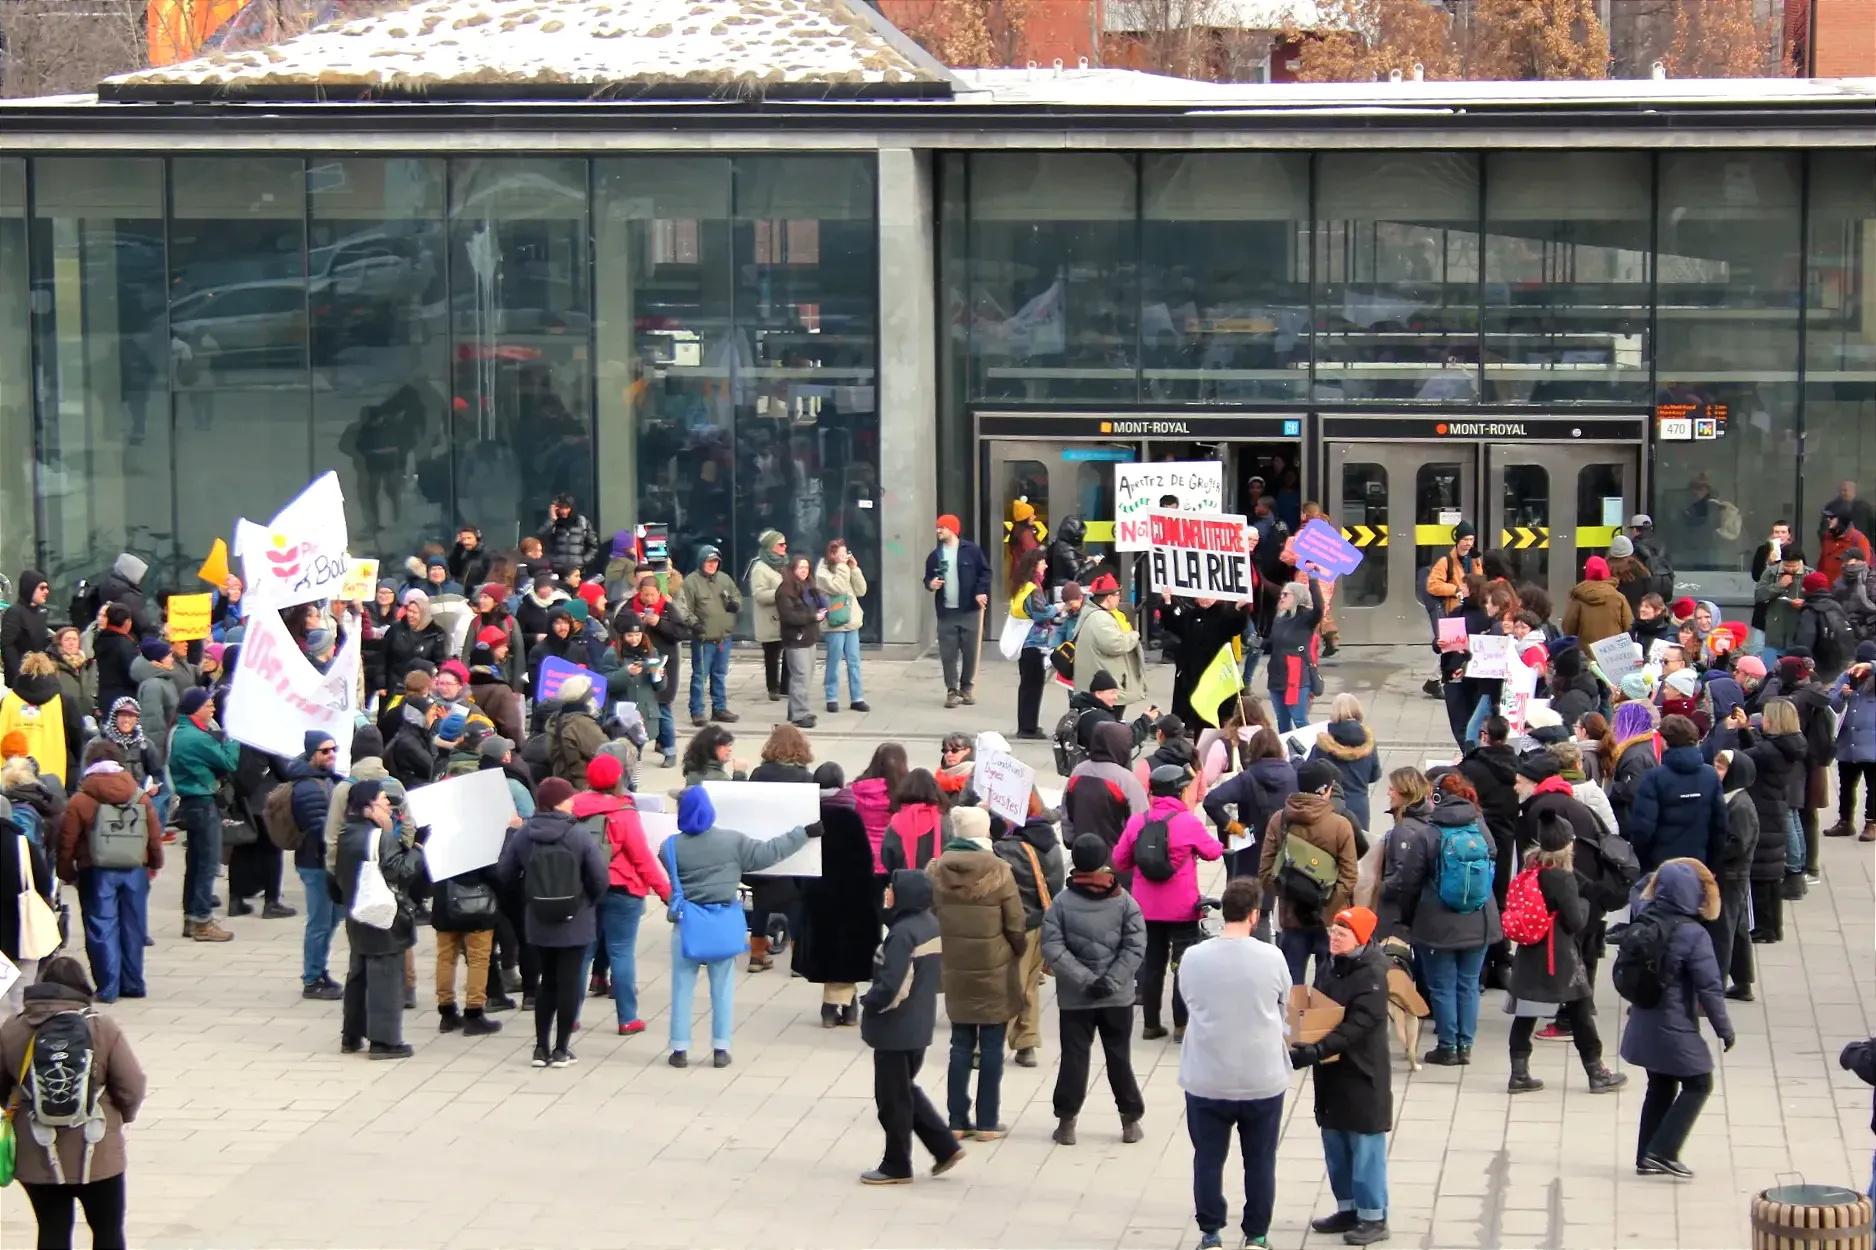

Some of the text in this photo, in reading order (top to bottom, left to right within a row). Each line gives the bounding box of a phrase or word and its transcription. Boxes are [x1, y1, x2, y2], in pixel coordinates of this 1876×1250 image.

[1114, 422, 1190, 434] MONT-ROYAL
[1450, 424, 1527, 435] MONT-ROYAL
[1667, 424, 1686, 434] 470
[1171, 474, 1185, 486] DE
[1153, 548, 1248, 594] À LA RUE
